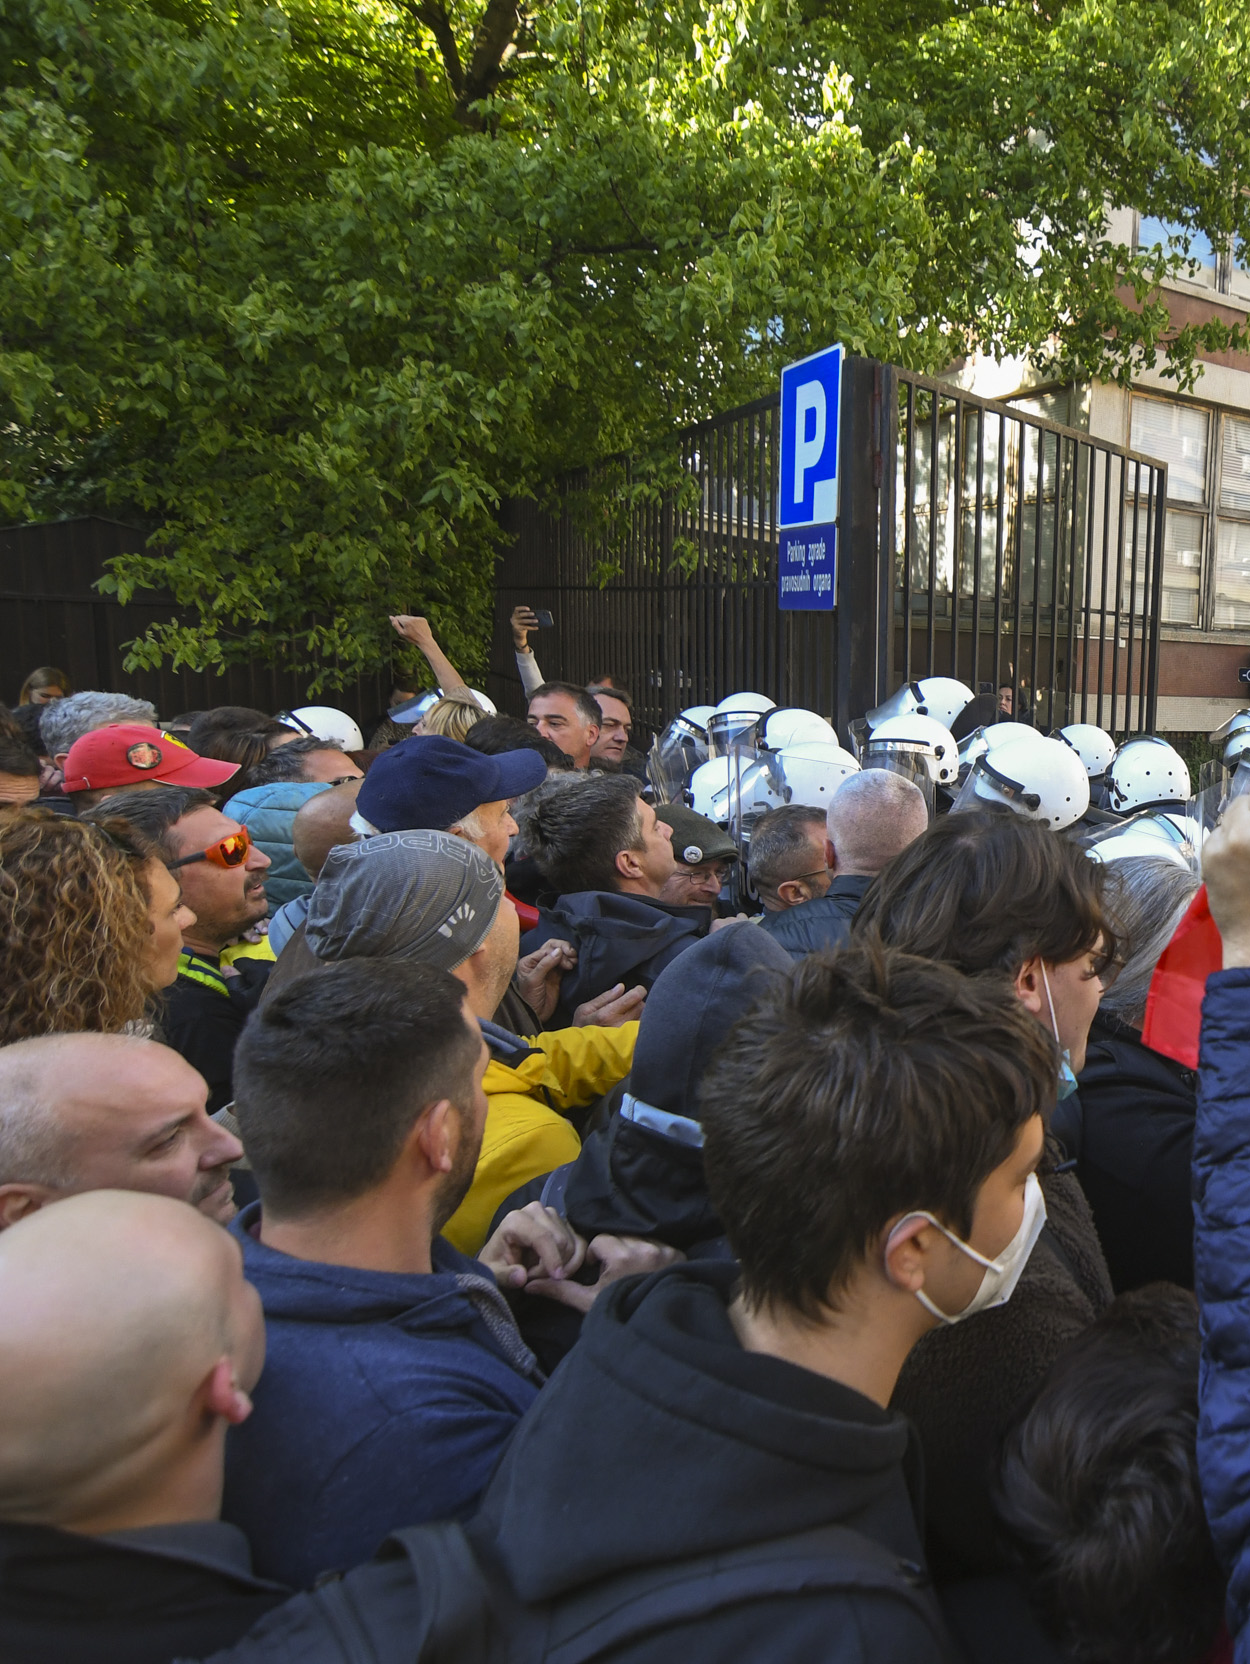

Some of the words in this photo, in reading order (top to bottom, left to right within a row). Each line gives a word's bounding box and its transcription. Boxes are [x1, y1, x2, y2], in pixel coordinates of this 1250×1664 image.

[794, 380, 827, 504] P
[787, 540, 806, 567] Parking
[808, 537, 826, 567] zgrade
[781, 569, 811, 598] pravosudnih
[812, 573, 831, 597] organa
